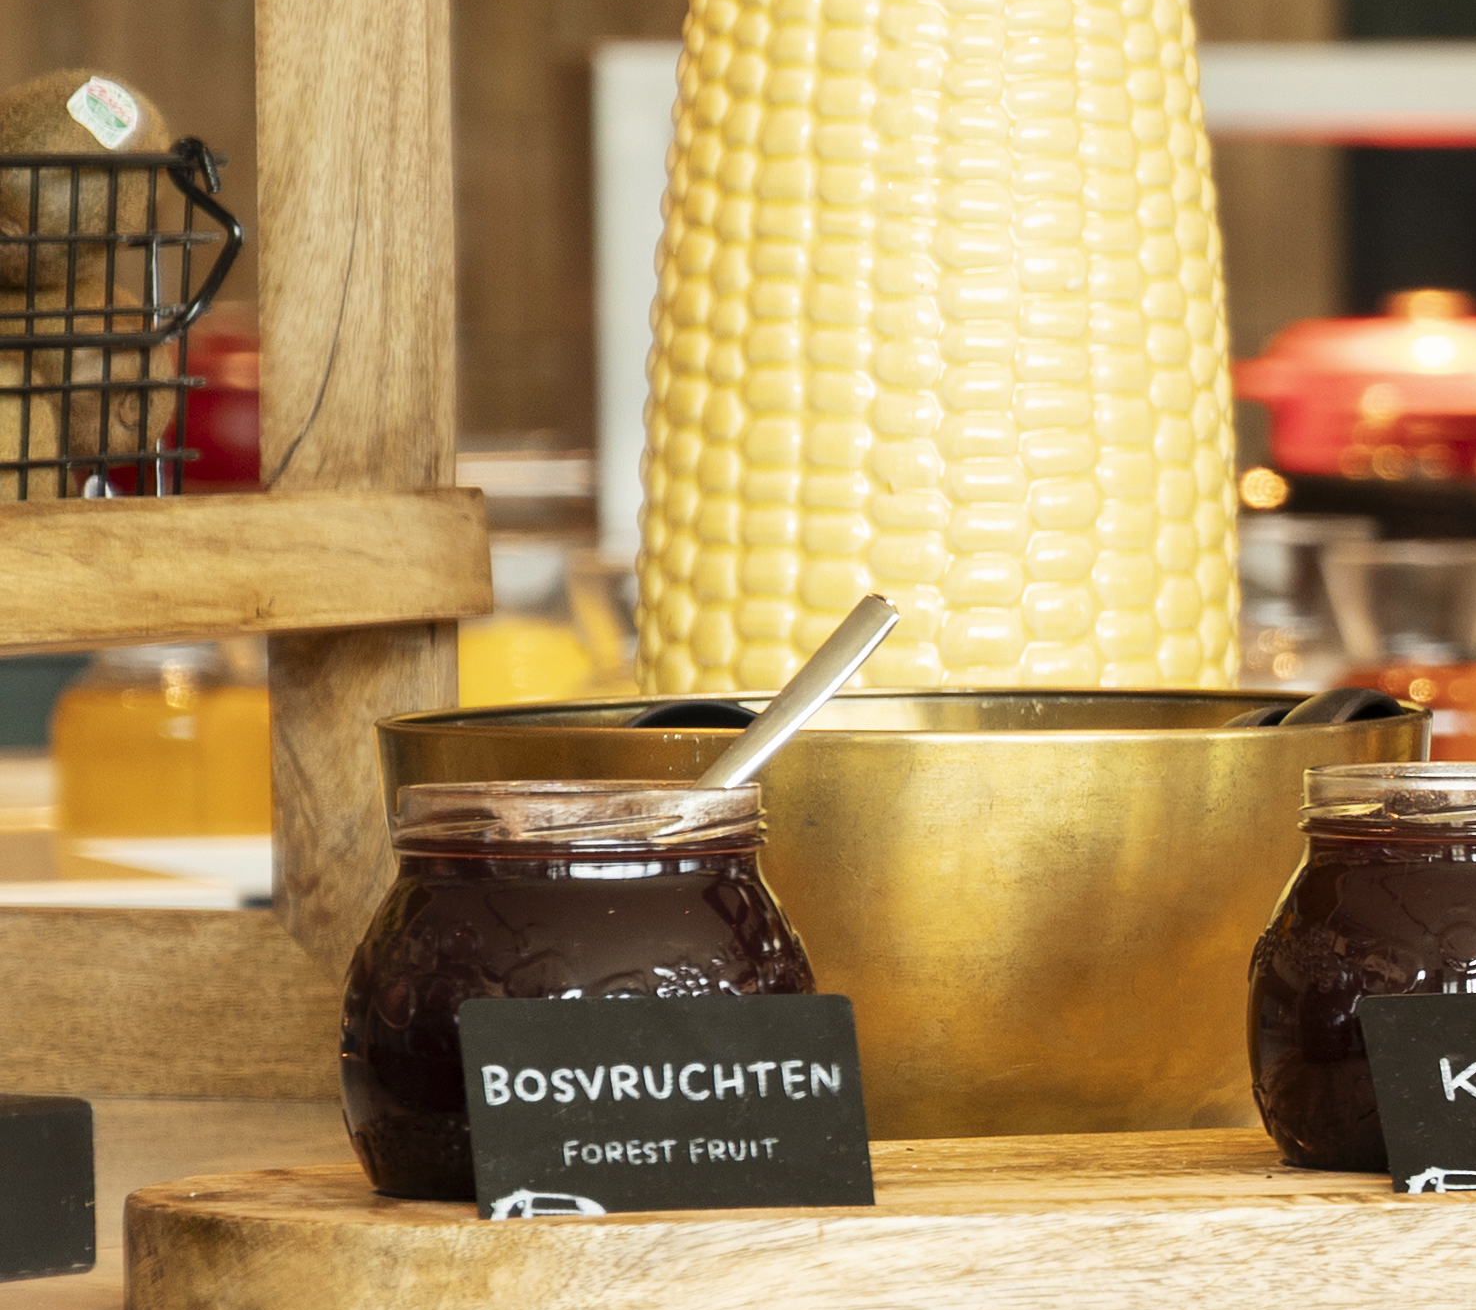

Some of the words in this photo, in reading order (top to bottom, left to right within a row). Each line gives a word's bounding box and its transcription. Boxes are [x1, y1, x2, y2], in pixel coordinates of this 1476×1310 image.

[482, 1060, 842, 1105] BOSVRUCHTEN
[563, 1139, 676, 1166] FOREST
[689, 1138, 780, 1164] FRUIT
